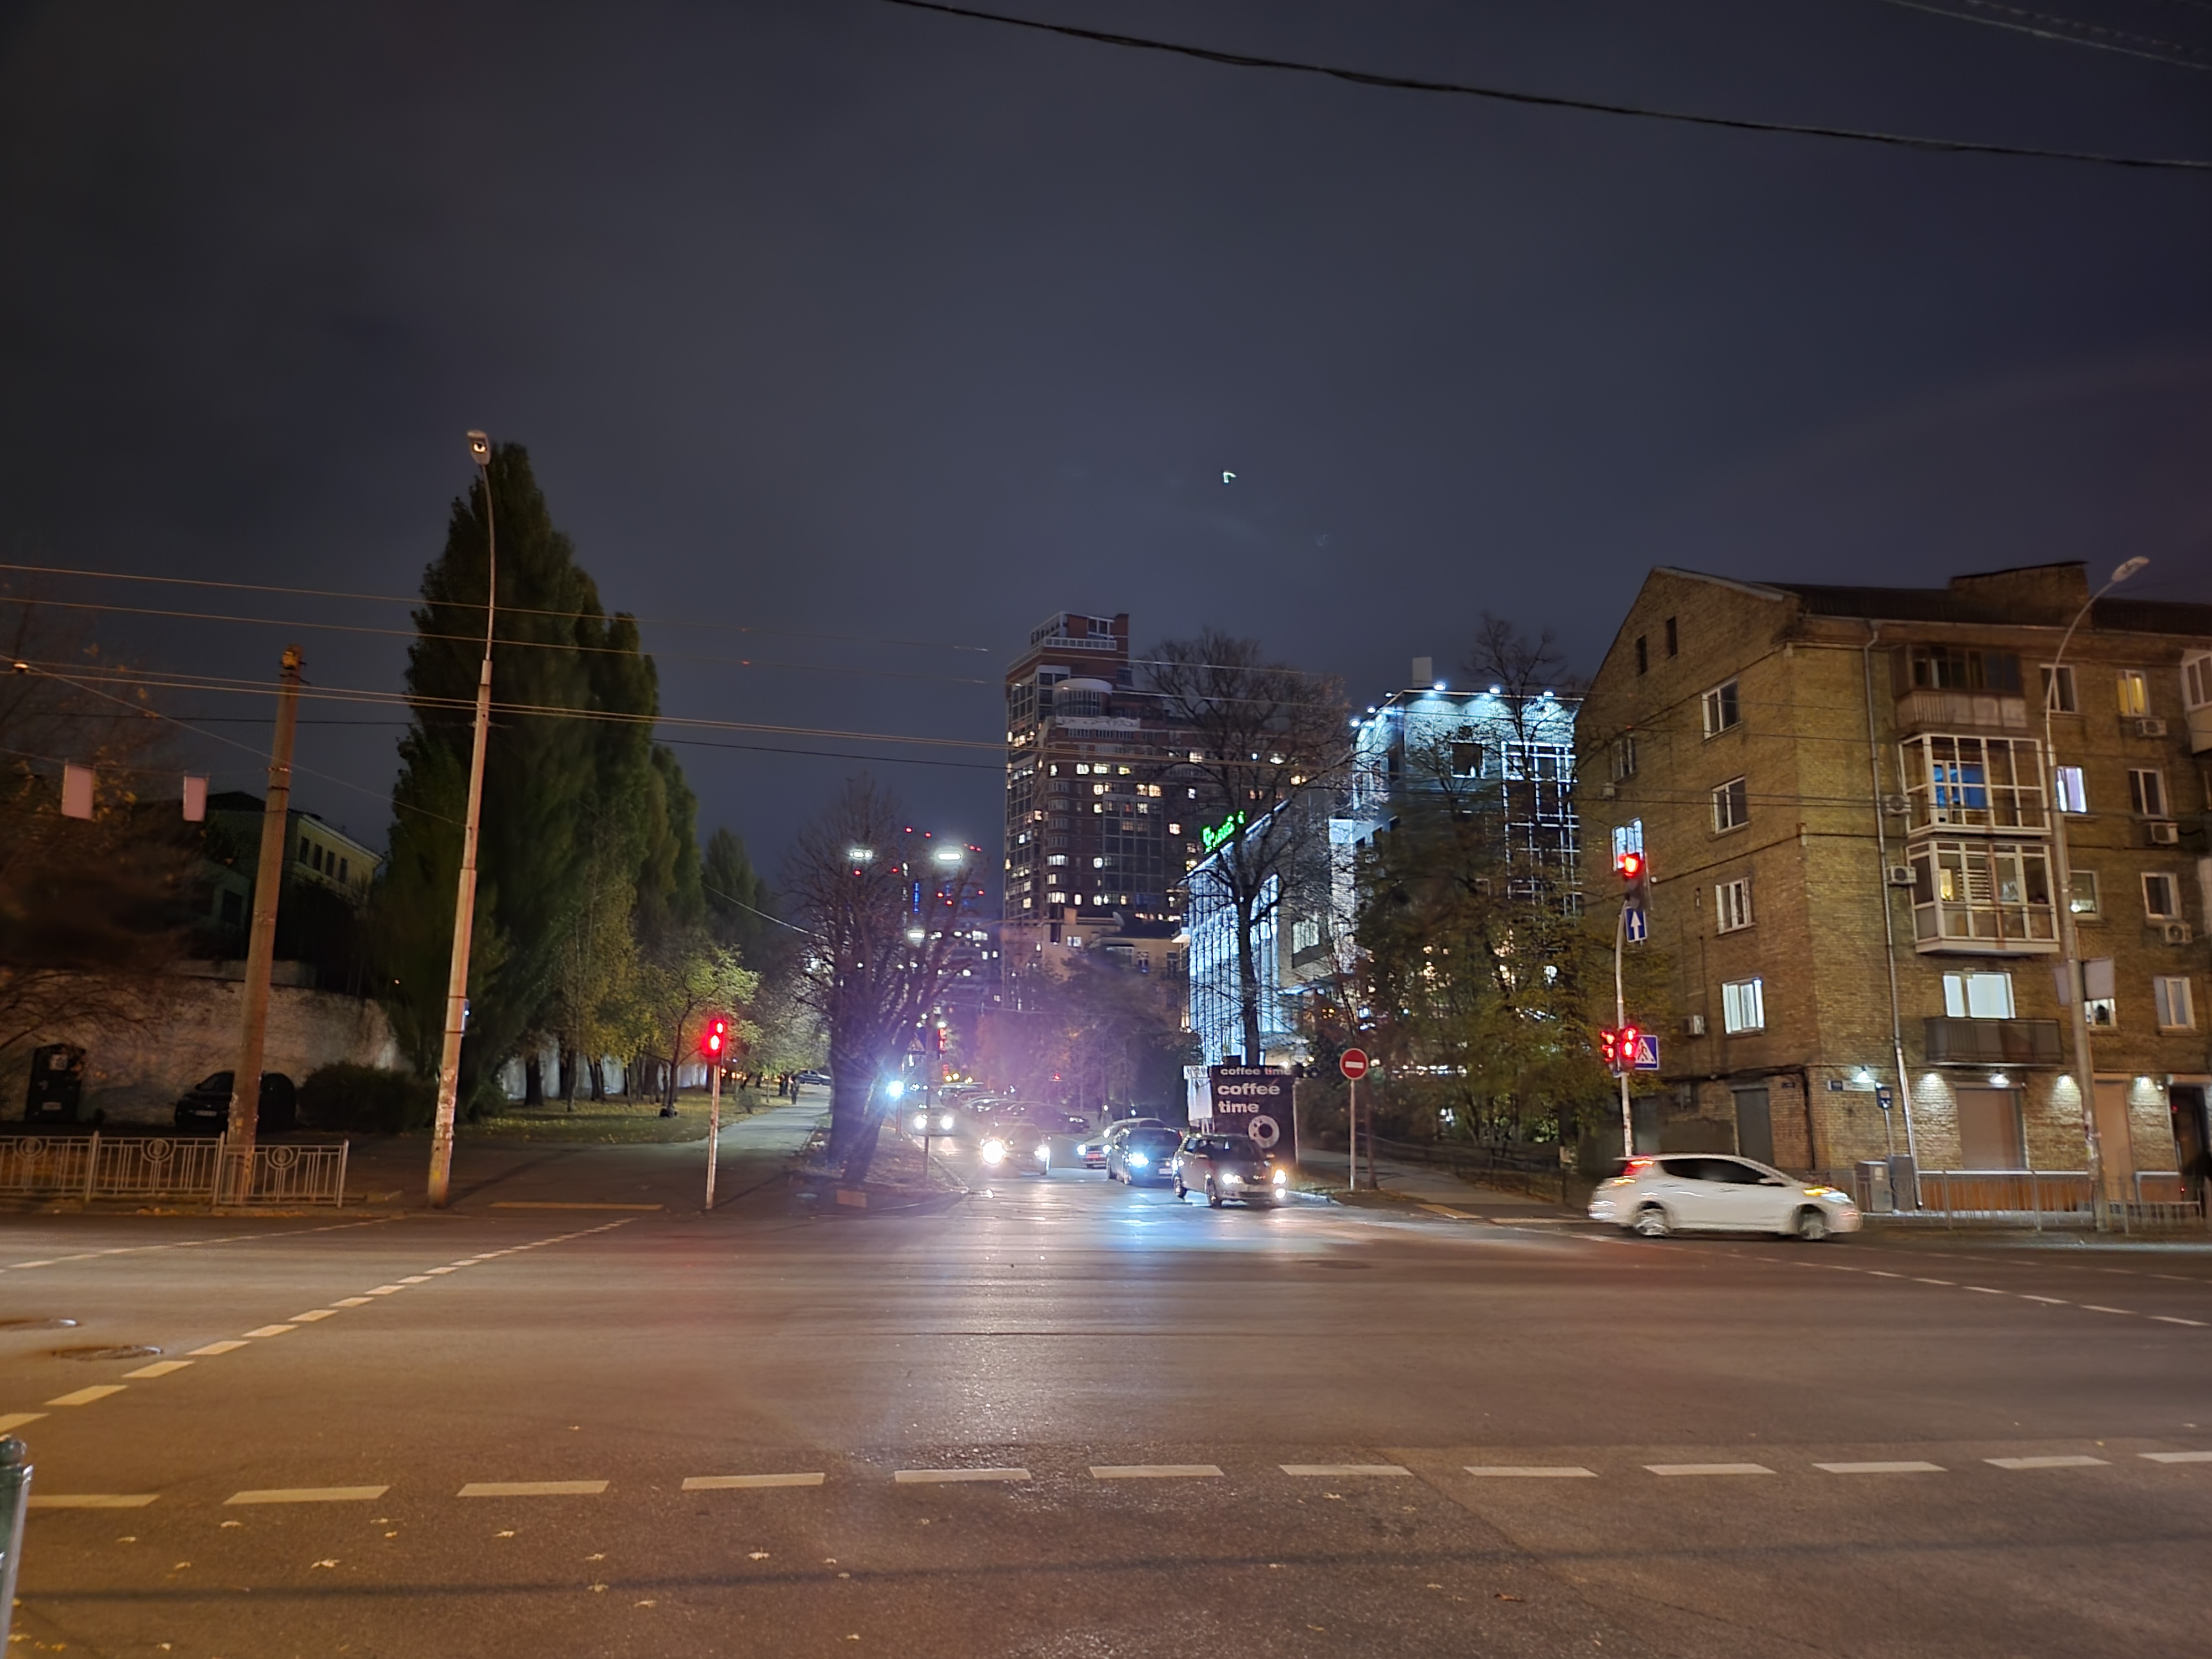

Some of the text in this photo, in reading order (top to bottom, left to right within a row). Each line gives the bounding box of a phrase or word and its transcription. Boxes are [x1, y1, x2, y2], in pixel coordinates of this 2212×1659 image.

[1220, 1067, 1292, 1076] coffee time
[1217, 1083, 1280, 1095] coffee
[1218, 1100, 1259, 1113] time
